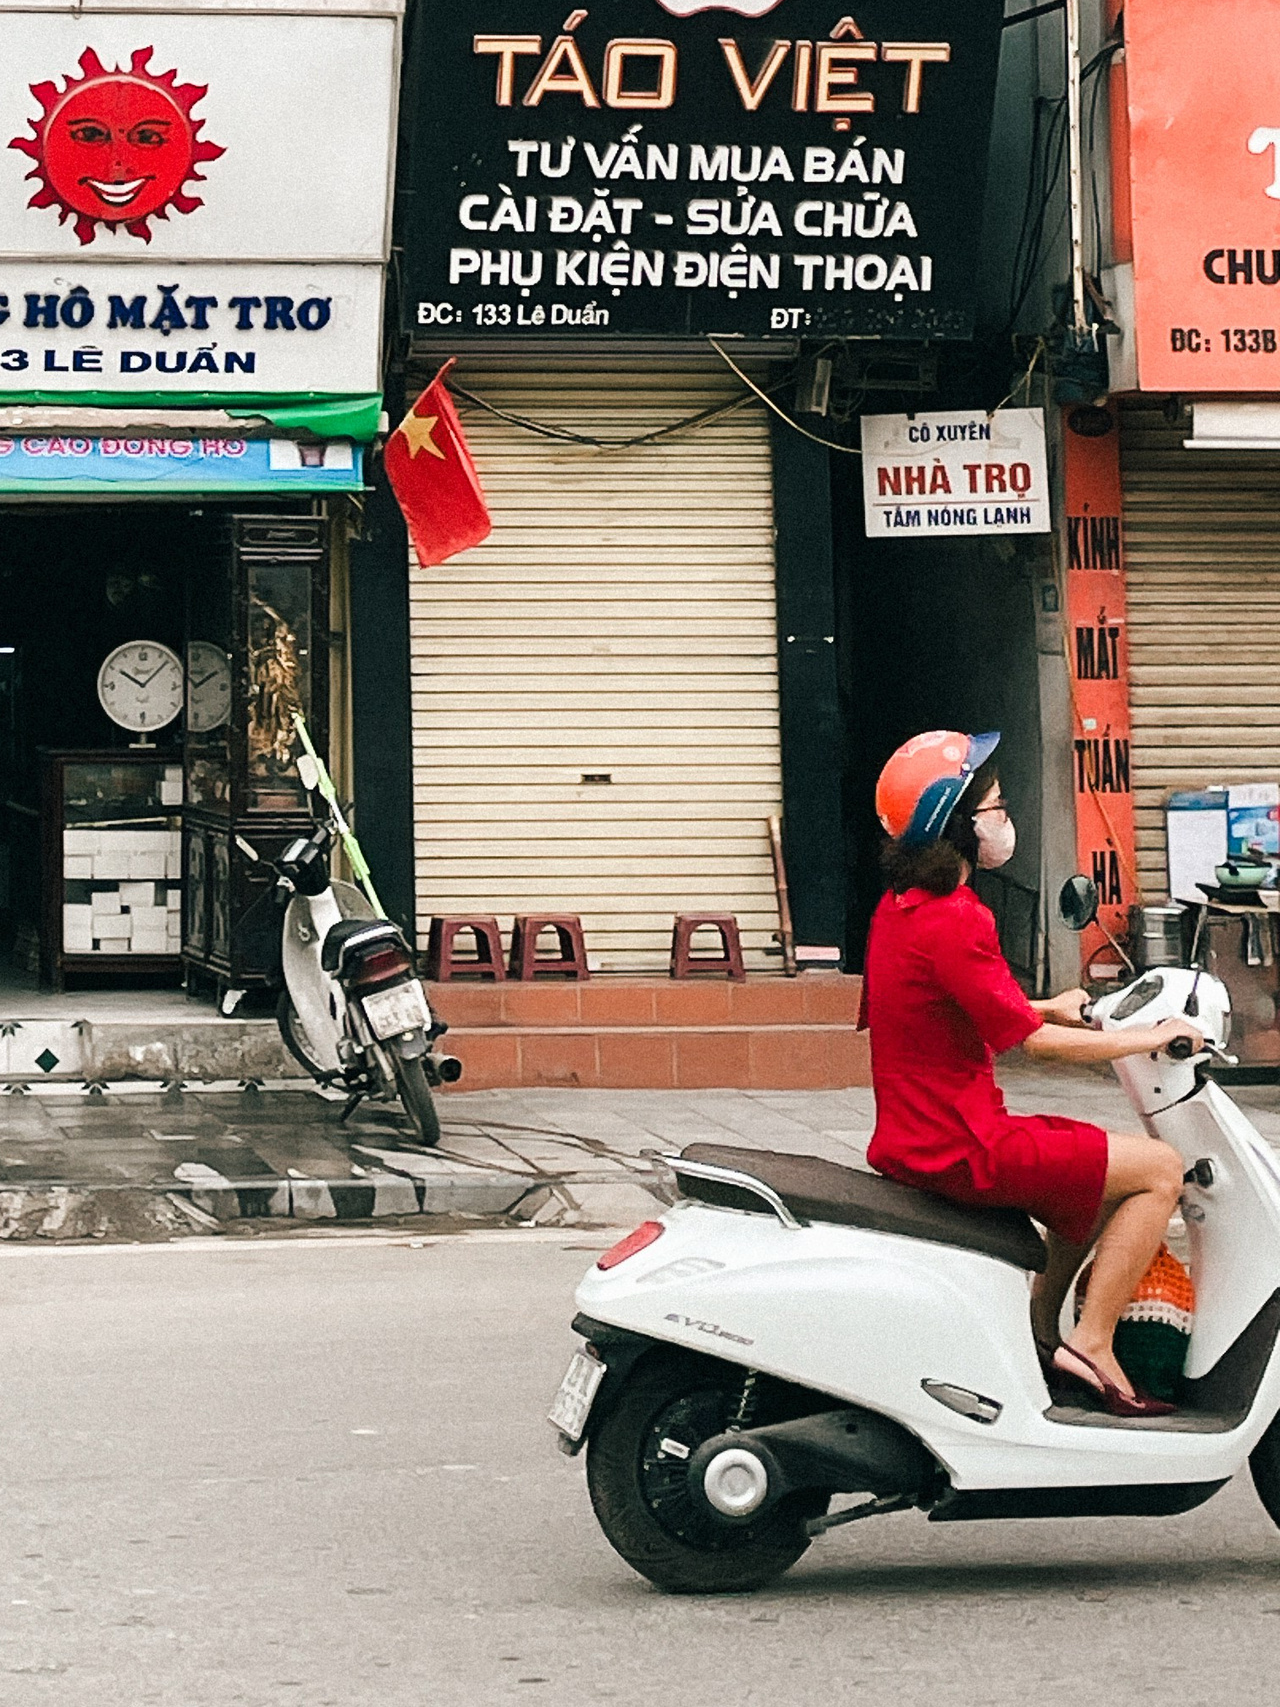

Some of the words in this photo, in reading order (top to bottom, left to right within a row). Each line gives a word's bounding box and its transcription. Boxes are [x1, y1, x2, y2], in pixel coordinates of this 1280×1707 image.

[474, 10, 678, 109] TÁO
[719, 16, 950, 131] VIỆT
[508, 136, 577, 179] TƯ
[584, 126, 679, 181] VẤN
[689, 146, 794, 184] MUA
[804, 135, 904, 186] BÁN
[460, 185, 536, 233] CÀI
[548, 189, 641, 241] ĐẶT
[687, 187, 782, 238] SỬA
[794, 191, 918, 239] CHỮA
[449, 248, 543, 300] PHỤ
[556, 243, 664, 297] KIỆN
[673, 244, 780, 300] ĐIỆN
[795, 256, 933, 302] THOẠI
[107, 283, 218, 337] MẶT
[417, 302, 463, 325] ĐC:
[472, 303, 511, 326] 133
[517, 303, 546, 326] Lê
[551, 300, 610, 326] Duẩn
[1220, 328, 1278, 354] 133B
[908, 422, 932, 443] CÔ
[936, 420, 991, 442] XUYÊN
[877, 457, 952, 497] NHÀ
[962, 461, 1032, 500] TRỌ
[927, 505, 978, 527] NÓNG
[983, 506, 1032, 528] LẠNH
[1067, 501, 1122, 571] KÍNH
[1090, 836, 1123, 906] HÀ
